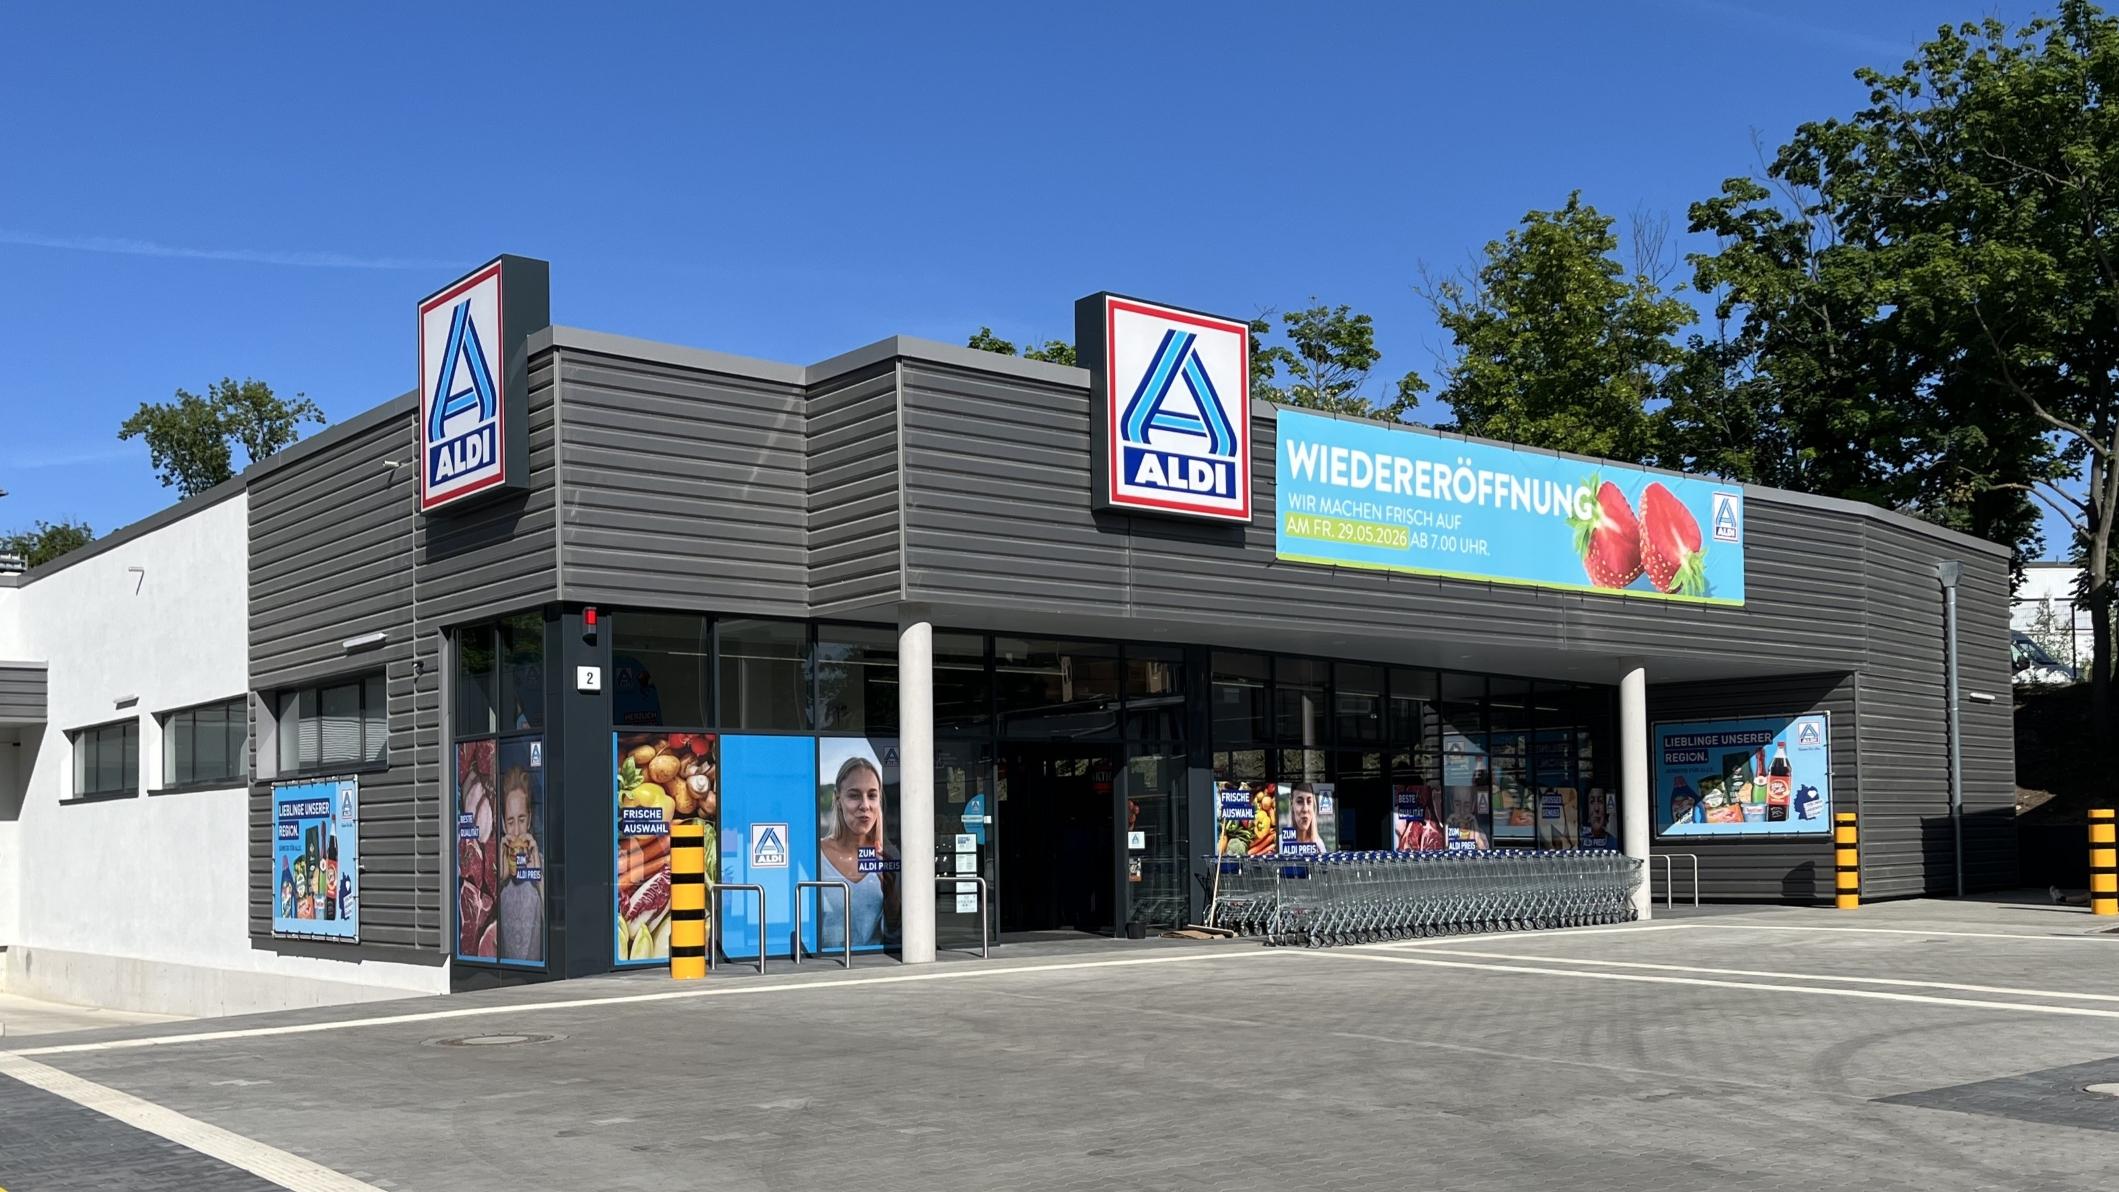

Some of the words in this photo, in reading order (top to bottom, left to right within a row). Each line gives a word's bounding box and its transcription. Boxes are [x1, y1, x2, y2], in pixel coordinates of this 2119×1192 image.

[435, 428, 490, 482] ALDI
[1134, 452, 1227, 495] ALDI
[1286, 438, 1593, 520] WIEDERERÖFFNUNG
[1288, 492, 1316, 512] WIR
[1320, 497, 1382, 521] MACHEN
[1386, 506, 1433, 527] FRISCH
[1436, 513, 1462, 531] AUF
[1286, 517, 1310, 534] AM
[1314, 519, 1335, 537] FR.
[1338, 522, 1407, 547] 29.05.2026
[1410, 533, 1428, 548] AB
[1431, 534, 1457, 551] 7.00
[1460, 537, 1491, 557] UHR.
[1717, 527, 1736, 538] ALDI
[587, 671, 594, 685] 2
[1664, 734, 1719, 748] LIEBLINGE
[1721, 732, 1772, 745] UNSERER
[1221, 792, 1250, 802] FRISCHE
[1398, 794, 1416, 804] BESTE
[278, 803, 304, 817] LIEBLINGE
[304, 801, 330, 815] UNSERER
[623, 809, 662, 819] FRISCHE
[1222, 808, 1255, 818] AUSWAHL
[1399, 808, 1424, 818] QUALITÄT
[623, 823, 669, 833] AUSWAHL
[1448, 828, 1460, 837] ZUM
[1282, 829, 1297, 840] ZUM
[1283, 845, 1298, 854] ALDI
[1298, 844, 1317, 854] PREIS
[1449, 841, 1460, 850] ALDI
[1461, 841, 1476, 850] PREIS
[859, 849, 876, 858] ZUM
[516, 855, 526, 865] ZUM
[757, 855, 782, 864] ALDI
[859, 862, 877, 871] ALDI
[878, 862, 900, 871] PREIS
[516, 869, 527, 879] ALDI
[527, 869, 541, 879] PREIS
